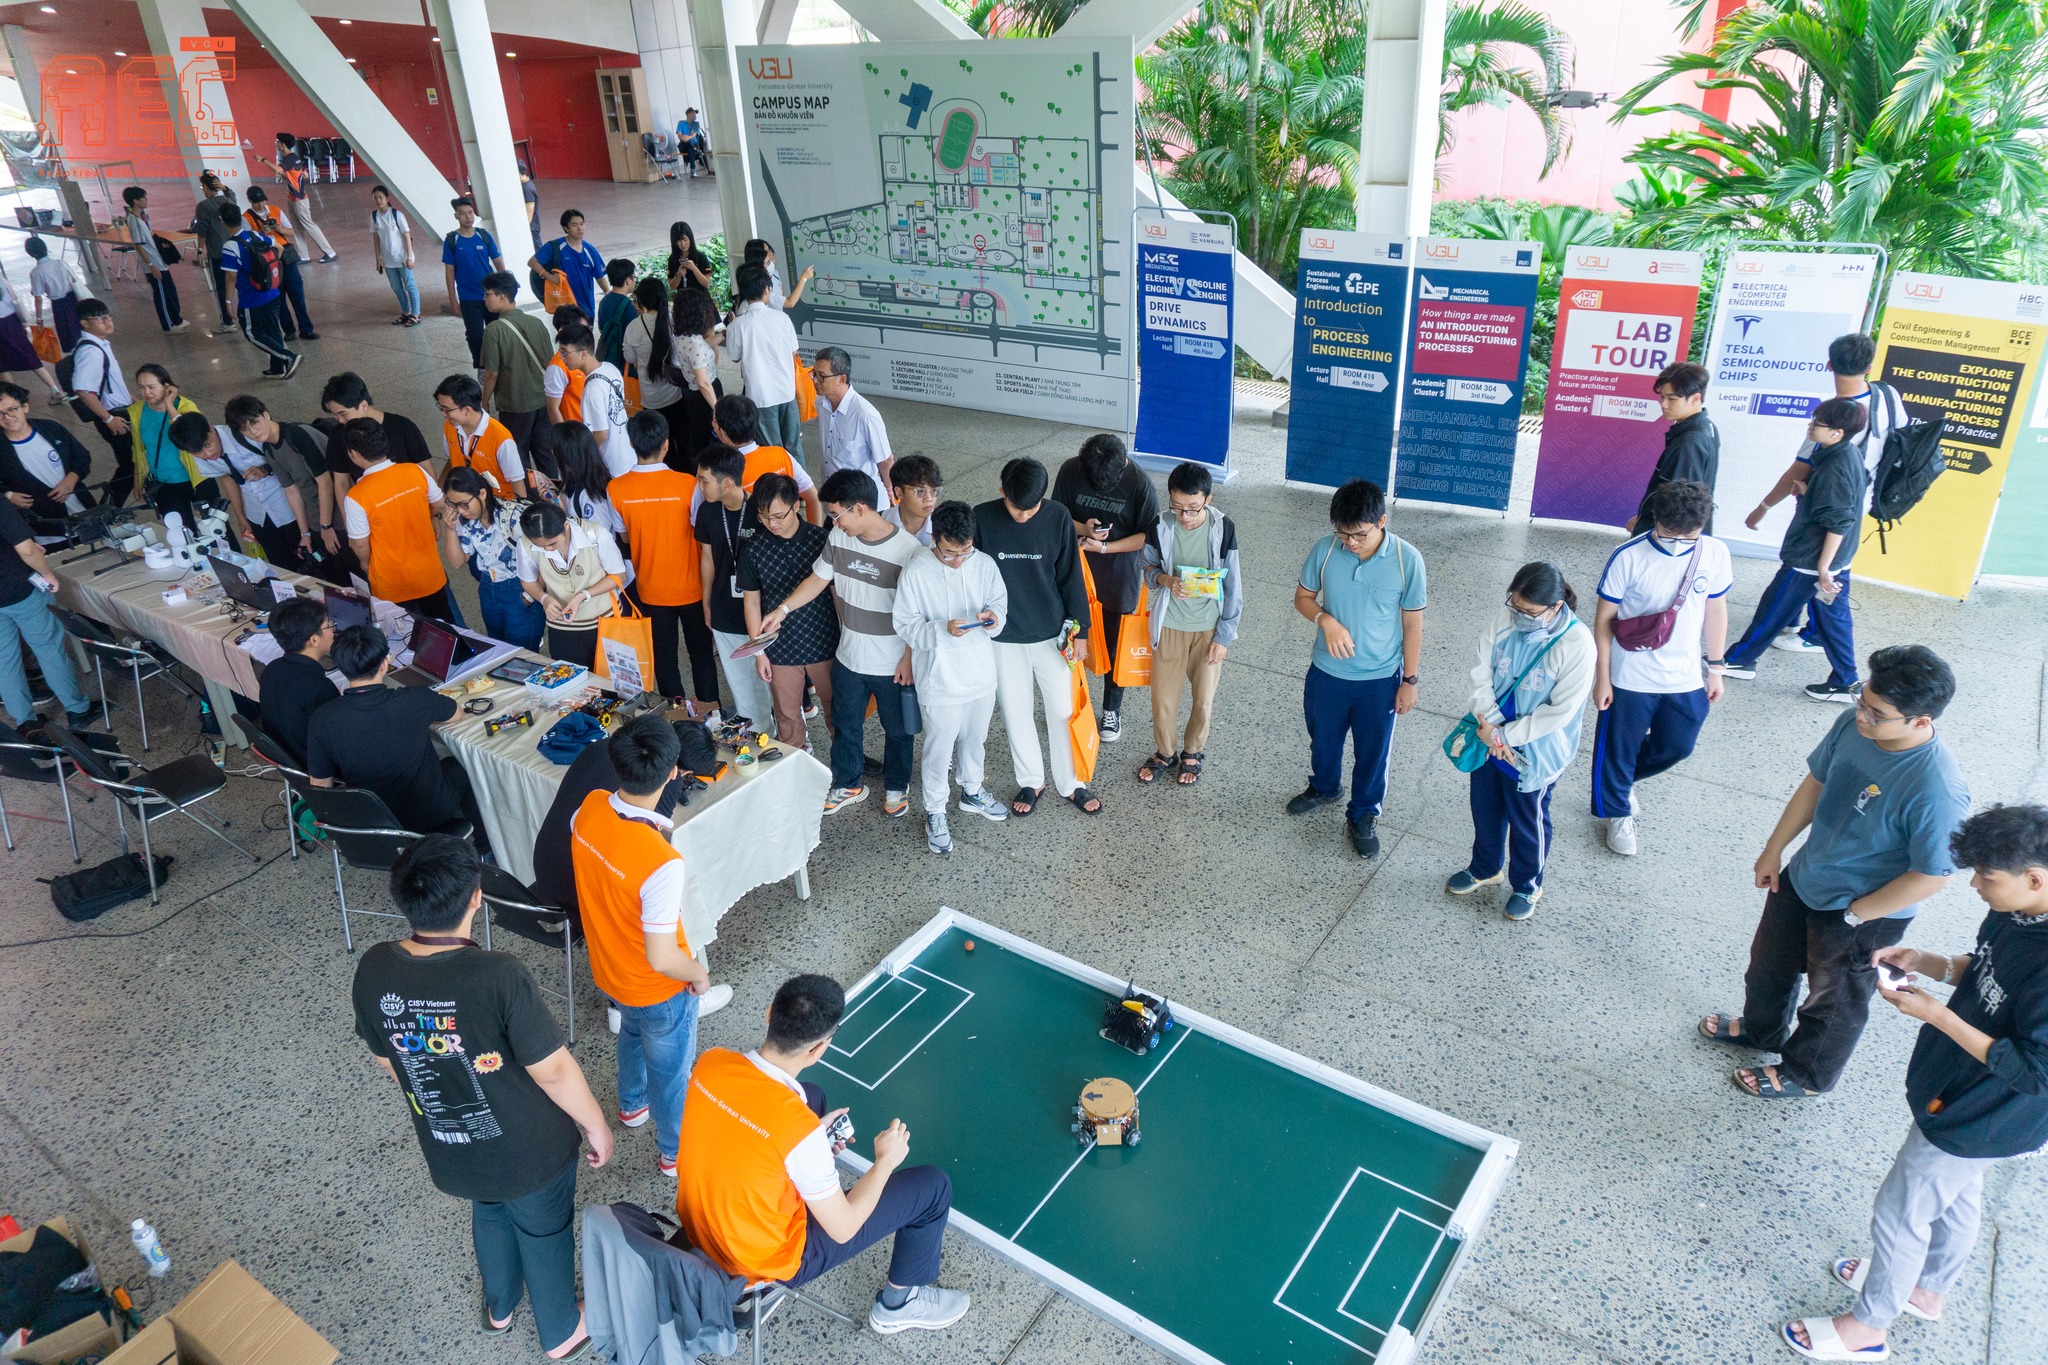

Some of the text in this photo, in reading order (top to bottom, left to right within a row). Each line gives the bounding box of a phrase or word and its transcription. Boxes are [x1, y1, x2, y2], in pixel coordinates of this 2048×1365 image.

[748, 57, 793, 79] VGU
[807, 83, 833, 91] University
[753, 96, 830, 110] CAMPUS MAP
[777, 111, 798, 119] KHUÔN
[798, 111, 814, 119] VIÊN
[1145, 264, 1179, 272] MECHATRONICS
[1306, 269, 1341, 278] Sustainable
[1145, 274, 1182, 284] ELECTRIC
[1173, 277, 1200, 298] VS
[1306, 282, 1340, 292] Engineering
[1740, 283, 1788, 292] ELECTRICAL
[1145, 284, 1228, 302] ENGINE ENGINE
[1452, 288, 1490, 296] MECHANICAL
[1742, 291, 1787, 300] COMPUTER
[1450, 294, 1490, 303] ENGINEERING
[1728, 298, 1786, 308] ENGINEERING
[1150, 301, 1182, 314] DRIVE
[1304, 297, 1383, 316] Introduction
[1303, 314, 1316, 326] to
[1421, 308, 1442, 318] How
[1444, 310, 1472, 320] things
[1490, 314, 1516, 322] made
[1150, 315, 1207, 330] DYNAMICS
[1420, 320, 1508, 334] AN INTRODUCTION
[1616, 320, 1672, 344] LAB
[1893, 322, 1912, 330] Civil
[1913, 324, 1963, 338] Engineering
[2010, 329, 2032, 340] BCE
[1152, 334, 1173, 342] Lecture
[1313, 328, 1370, 344] PROCESS
[1420, 331, 1518, 346] TO MANUFACTURING
[1418, 342, 1474, 354] PROCESSES
[1890, 332, 2000, 354] Construction Management
[1312, 344, 1393, 363] ENGINEERING
[1725, 344, 1764, 354] TESLA
[1592, 344, 1668, 370] TOUR
[1306, 365, 1330, 374] Lecture
[1342, 370, 1376, 380] ROOM 419
[1959, 364, 2015, 380] EXPLORE
[897, 378, 922, 386] DORMITORY
[1004, 373, 1024, 381] CENTRAL
[1316, 376, 1329, 384] Hall
[1559, 372, 1588, 382] Practice
[1590, 374, 1610, 384] place
[1719, 371, 1758, 382] CHIPS
[1892, 366, 2011, 392] THE CONSTRUCTION
[1412, 378, 1446, 388] Academic
[1460, 382, 1497, 392] ROOM 304
[1558, 381, 1616, 391] future architects
[900, 385, 925, 394] DORMITORY
[1414, 388, 1438, 397] Cluster
[1481, 393, 1496, 401] Floor
[1555, 394, 1592, 404] Academic
[1718, 394, 1748, 402] Lecture
[1766, 396, 1810, 406] ROOM 410
[1954, 388, 2007, 405] MORTAR
[1555, 404, 1582, 412] Cluster
[1608, 398, 1648, 409] ROOM 304
[1902, 392, 2004, 416] MANUFACTURING
[1400, 408, 1494, 429] MECHANICAL
[1618, 408, 1646, 418] 3rd Floor
[1944, 412, 2000, 428] PROCESS
[1944, 423, 1998, 440] to Practice
[1422, 428, 1516, 450] ENGINEERING
[1460, 448, 1514, 467] ENGINE
[1956, 450, 1974, 460] 108
[1950, 460, 1971, 470] Floor
[1419, 462, 1512, 484] MECHANICAL
[382, 1014, 456, 1030] album TRUE
[389, 1032, 464, 1054] COLOR
[739, 1115, 770, 1139] University
